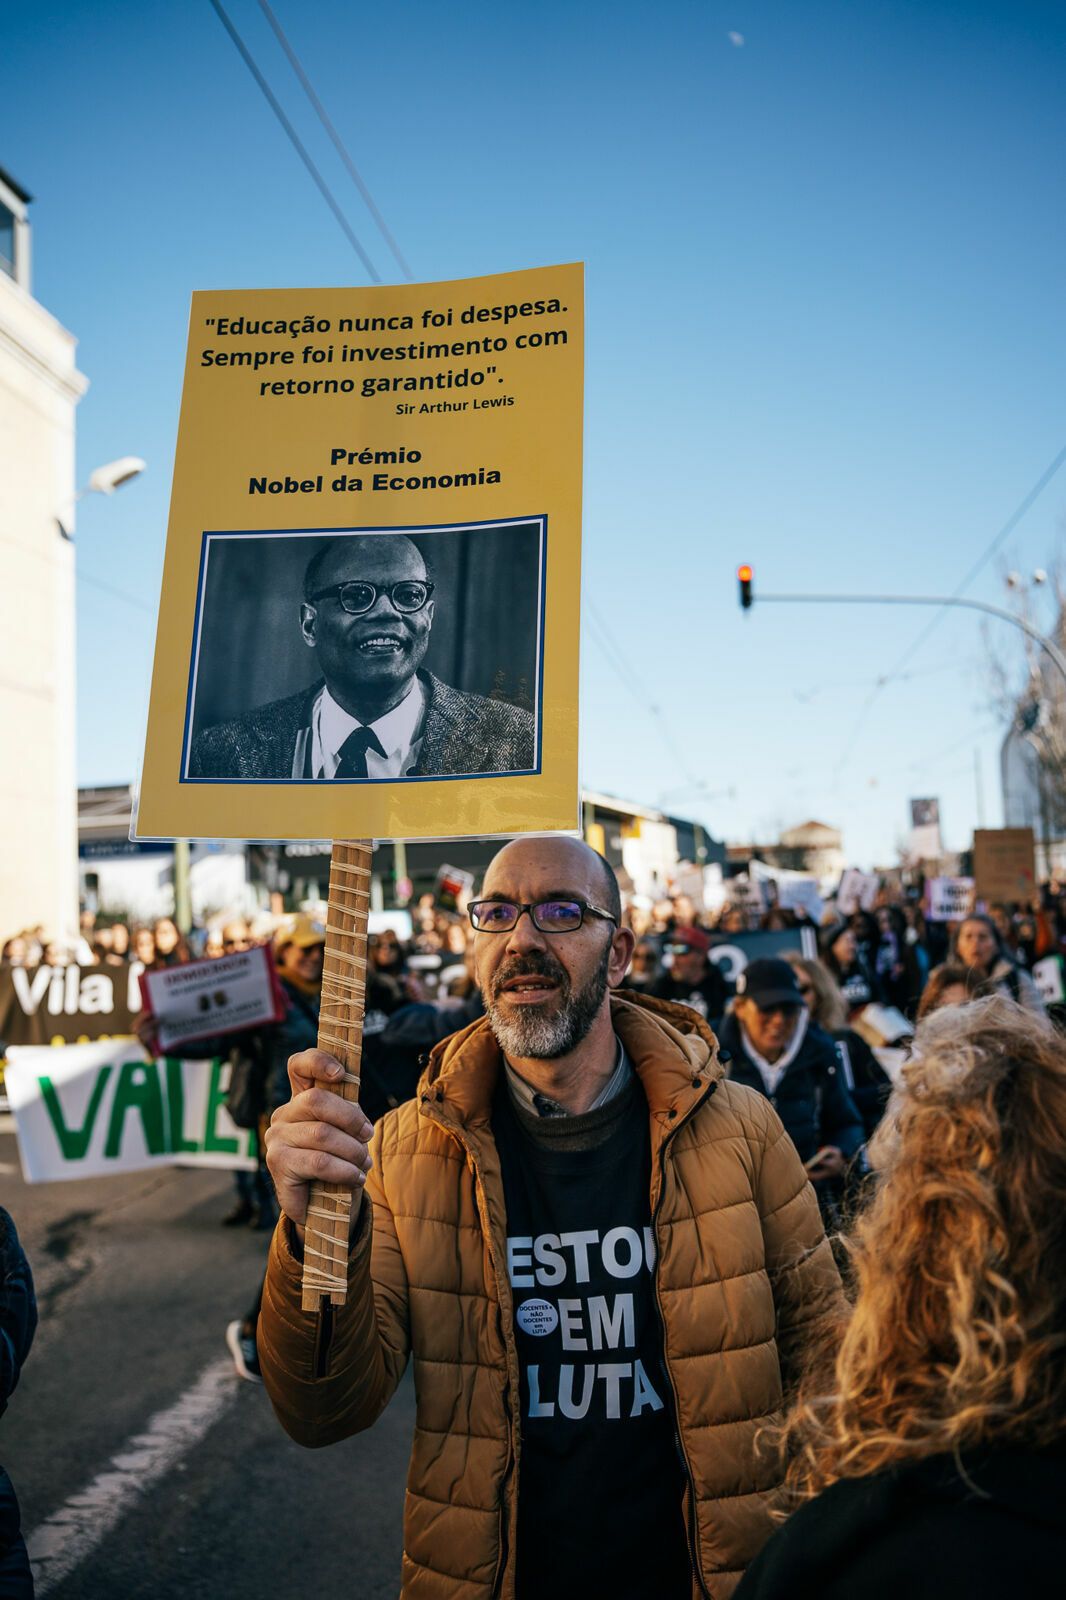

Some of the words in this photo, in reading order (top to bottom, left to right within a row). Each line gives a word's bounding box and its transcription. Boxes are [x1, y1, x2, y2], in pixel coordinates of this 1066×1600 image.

[205, 315, 331, 339] "Educação
[338, 316, 414, 332] nunca
[420, 308, 453, 328] foi
[460, 298, 568, 325] despesa.
[200, 349, 295, 370] Sempre
[301, 344, 334, 364] foi
[341, 336, 508, 362] investimento
[515, 328, 568, 348] com
[259, 378, 355, 396] retorno
[360, 366, 506, 398] garantido".
[395, 403, 416, 415] Sir
[418, 401, 469, 414] Arthur
[473, 394, 515, 410] Lewis
[330, 446, 422, 466] Prémio
[248, 475, 323, 495] Nobel
[331, 474, 363, 493] da
[372, 467, 501, 491] Economia
[12, 964, 114, 1015] Vila
[557, 1293, 636, 1351] EM
[527, 1359, 664, 1420] LUTA
